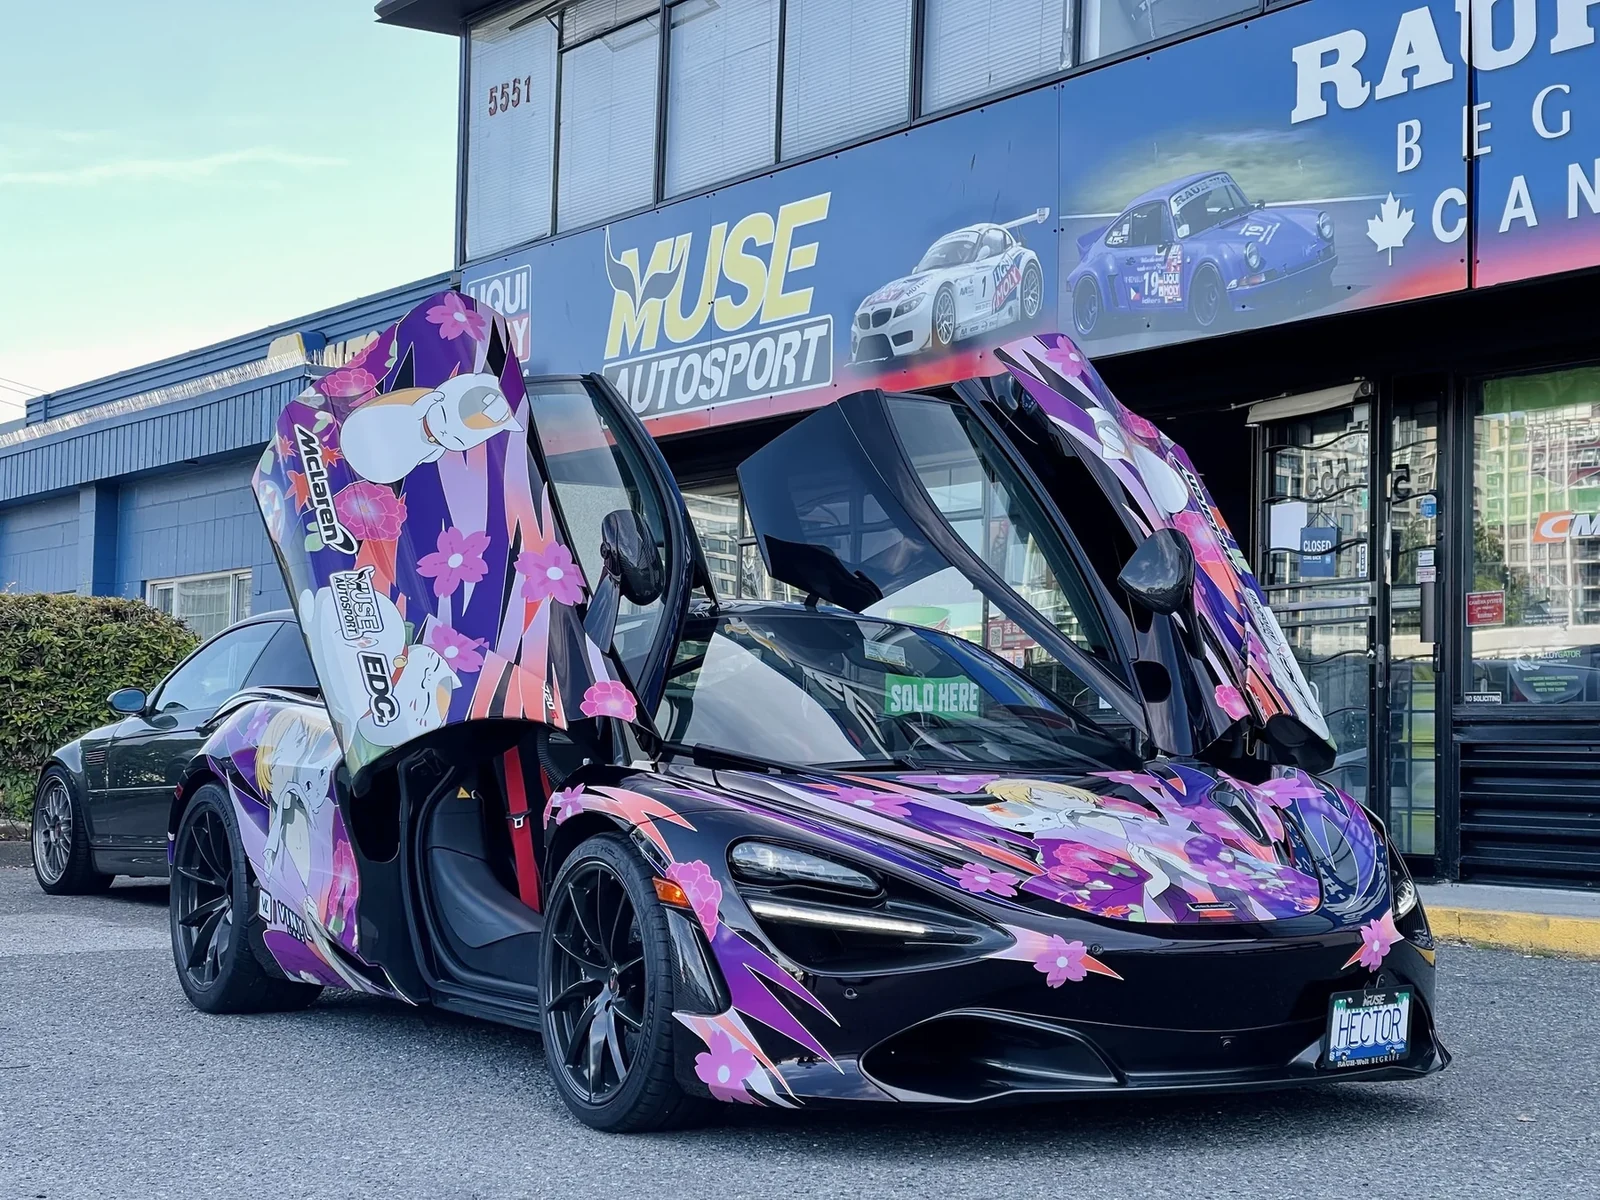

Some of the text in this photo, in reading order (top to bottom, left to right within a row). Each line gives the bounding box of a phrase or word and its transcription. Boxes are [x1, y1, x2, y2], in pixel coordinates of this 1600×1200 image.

[489, 75, 531, 116] 5551
[604, 192, 832, 360] MUSE
[1143, 271, 1159, 296] 19
[615, 323, 829, 413] AUTOSPORT
[297, 426, 345, 546] McLaren
[1303, 540, 1332, 553] CLOSED
[335, 577, 358, 635] AUTOSPORT
[345, 570, 379, 631] MUSE
[891, 682, 979, 712] SOLD HERE
[1363, 990, 1386, 1007] MUSE
[1337, 1007, 1402, 1047] HECTOR
